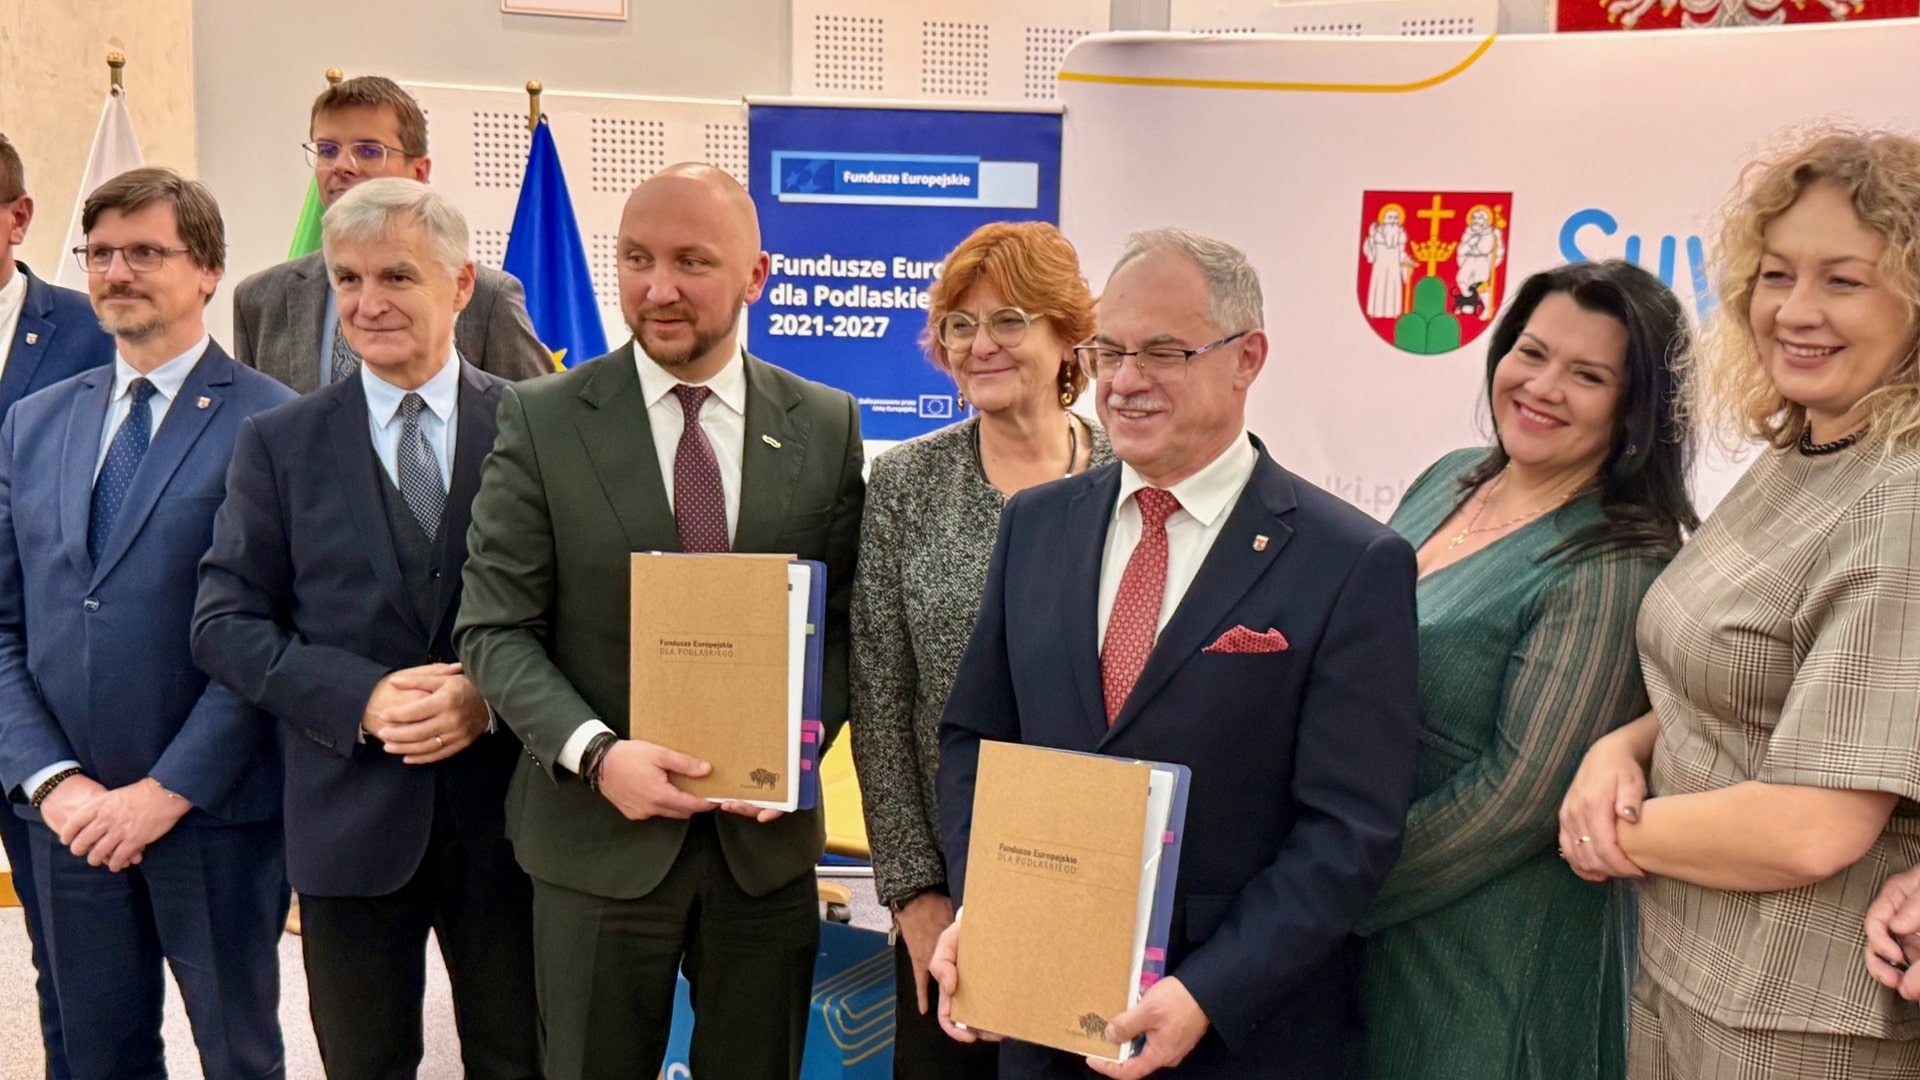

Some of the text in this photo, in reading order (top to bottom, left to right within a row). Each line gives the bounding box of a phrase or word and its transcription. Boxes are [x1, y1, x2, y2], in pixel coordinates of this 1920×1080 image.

[843, 171, 971, 187] Fundusze Europejskie
[771, 254, 945, 280] Fundusze Euro
[769, 283, 932, 309] dla Podlaskie
[769, 314, 890, 338] 2021-2027
[1326, 475, 1405, 513] lki.pl
[659, 639, 733, 649] Fundusze Europejskie
[659, 648, 734, 658] DLA PODLASKIEGO
[997, 853, 1077, 875] DLA PODLASKIEGO
[998, 842, 1078, 864] Fundusze Europejskie
